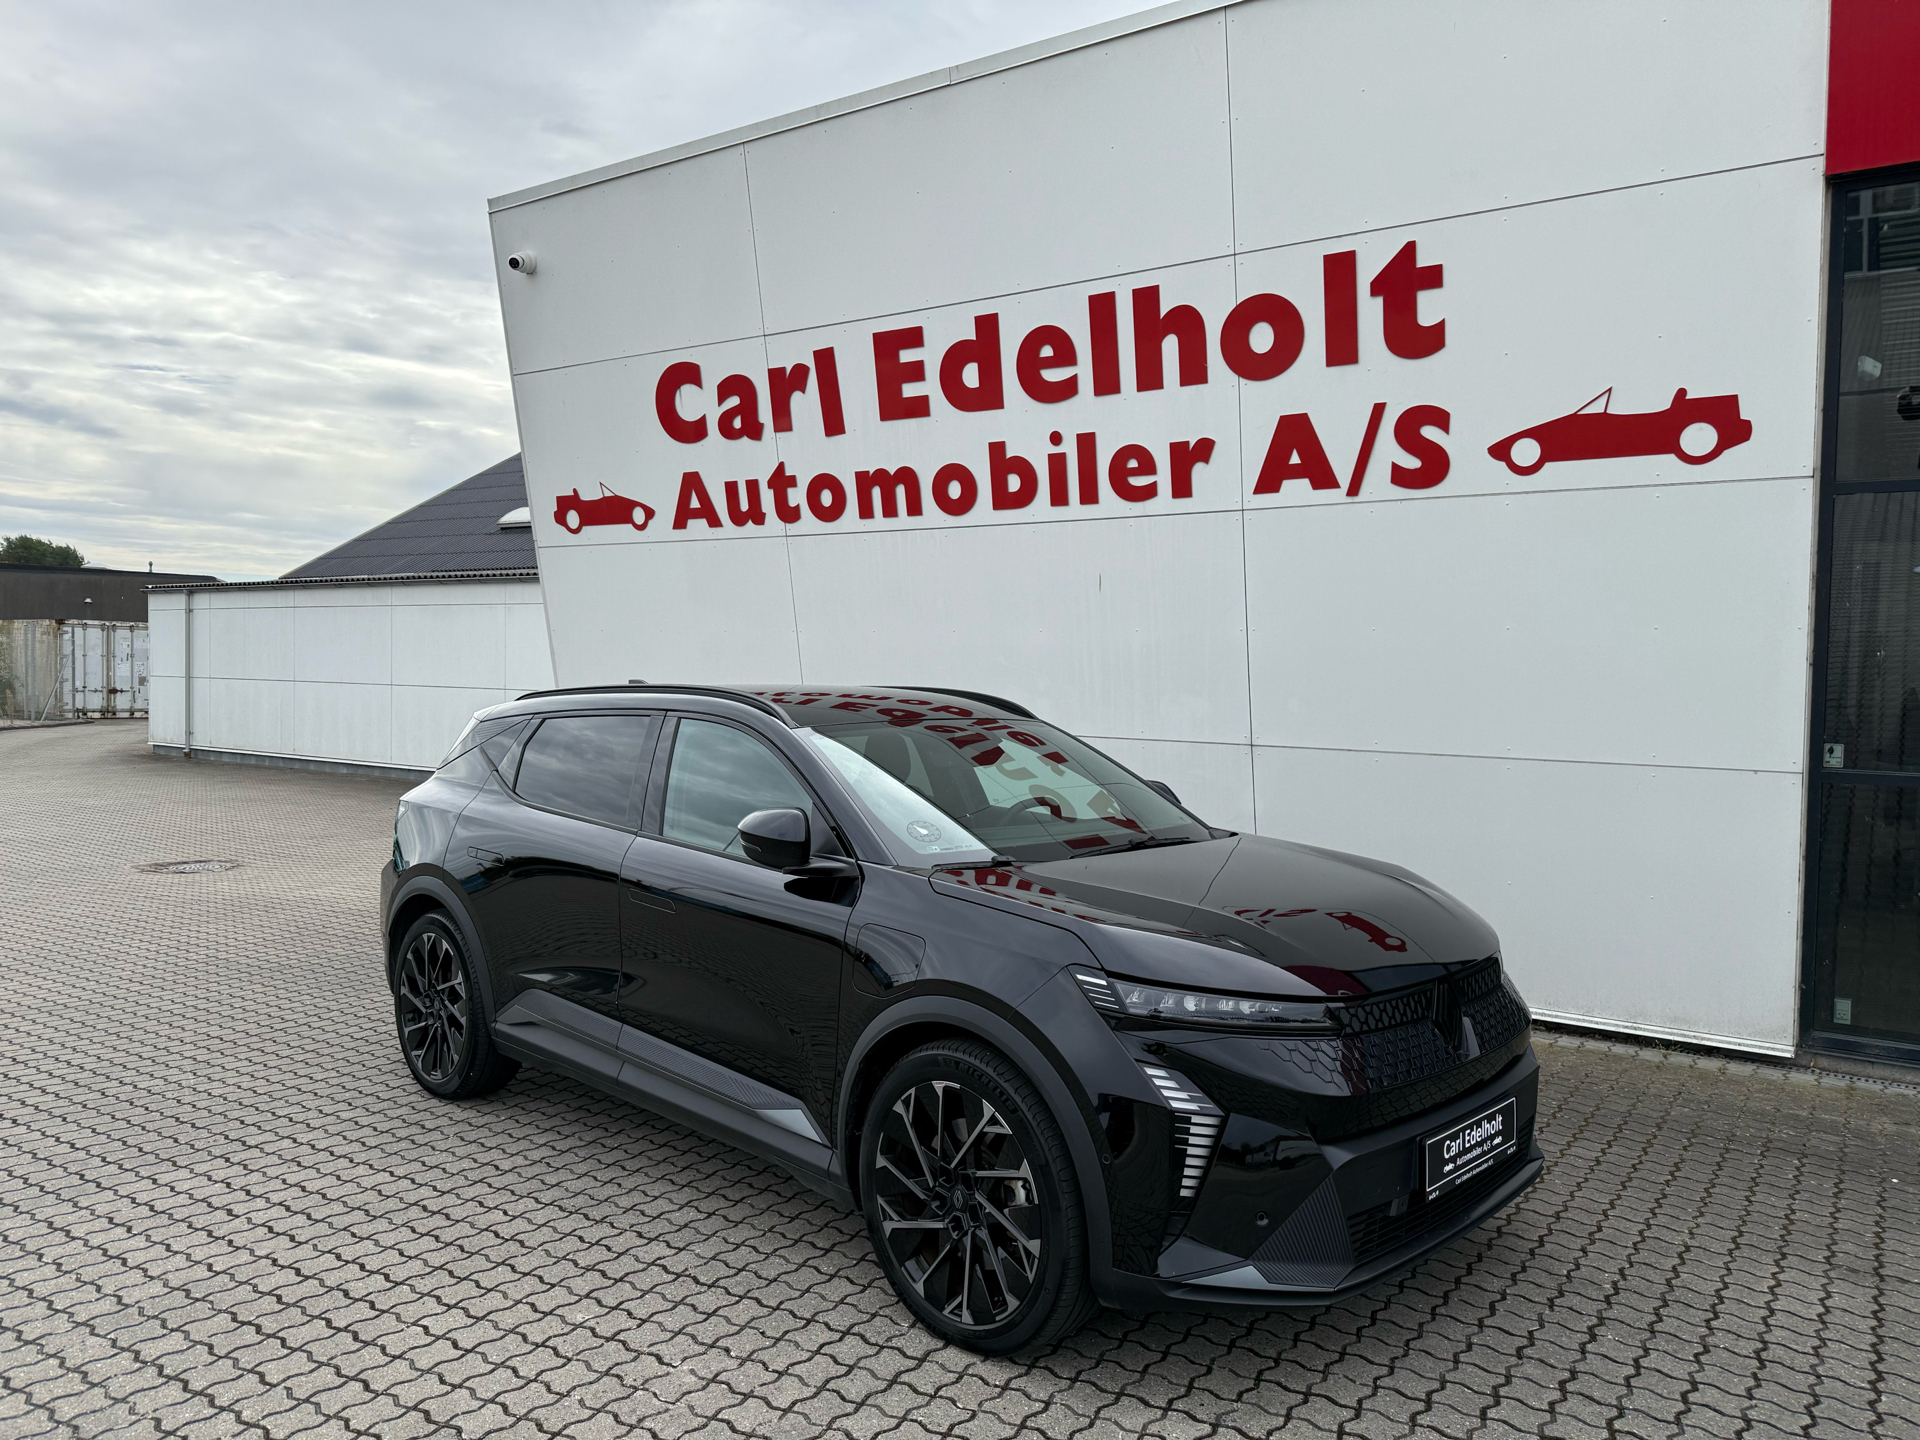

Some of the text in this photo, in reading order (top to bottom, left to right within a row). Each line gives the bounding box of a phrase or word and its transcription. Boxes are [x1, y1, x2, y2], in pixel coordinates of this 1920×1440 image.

[656, 241, 1444, 443] Carl Edelholt
[673, 403, 1449, 529] Automobiler A/S
[958, 1061, 1018, 1114] MICHELIN
[1444, 1113, 1502, 1159] Carl Edelholt
[1456, 1146, 1483, 1166] Automobiler
[1483, 1140, 1491, 1151] A/S
